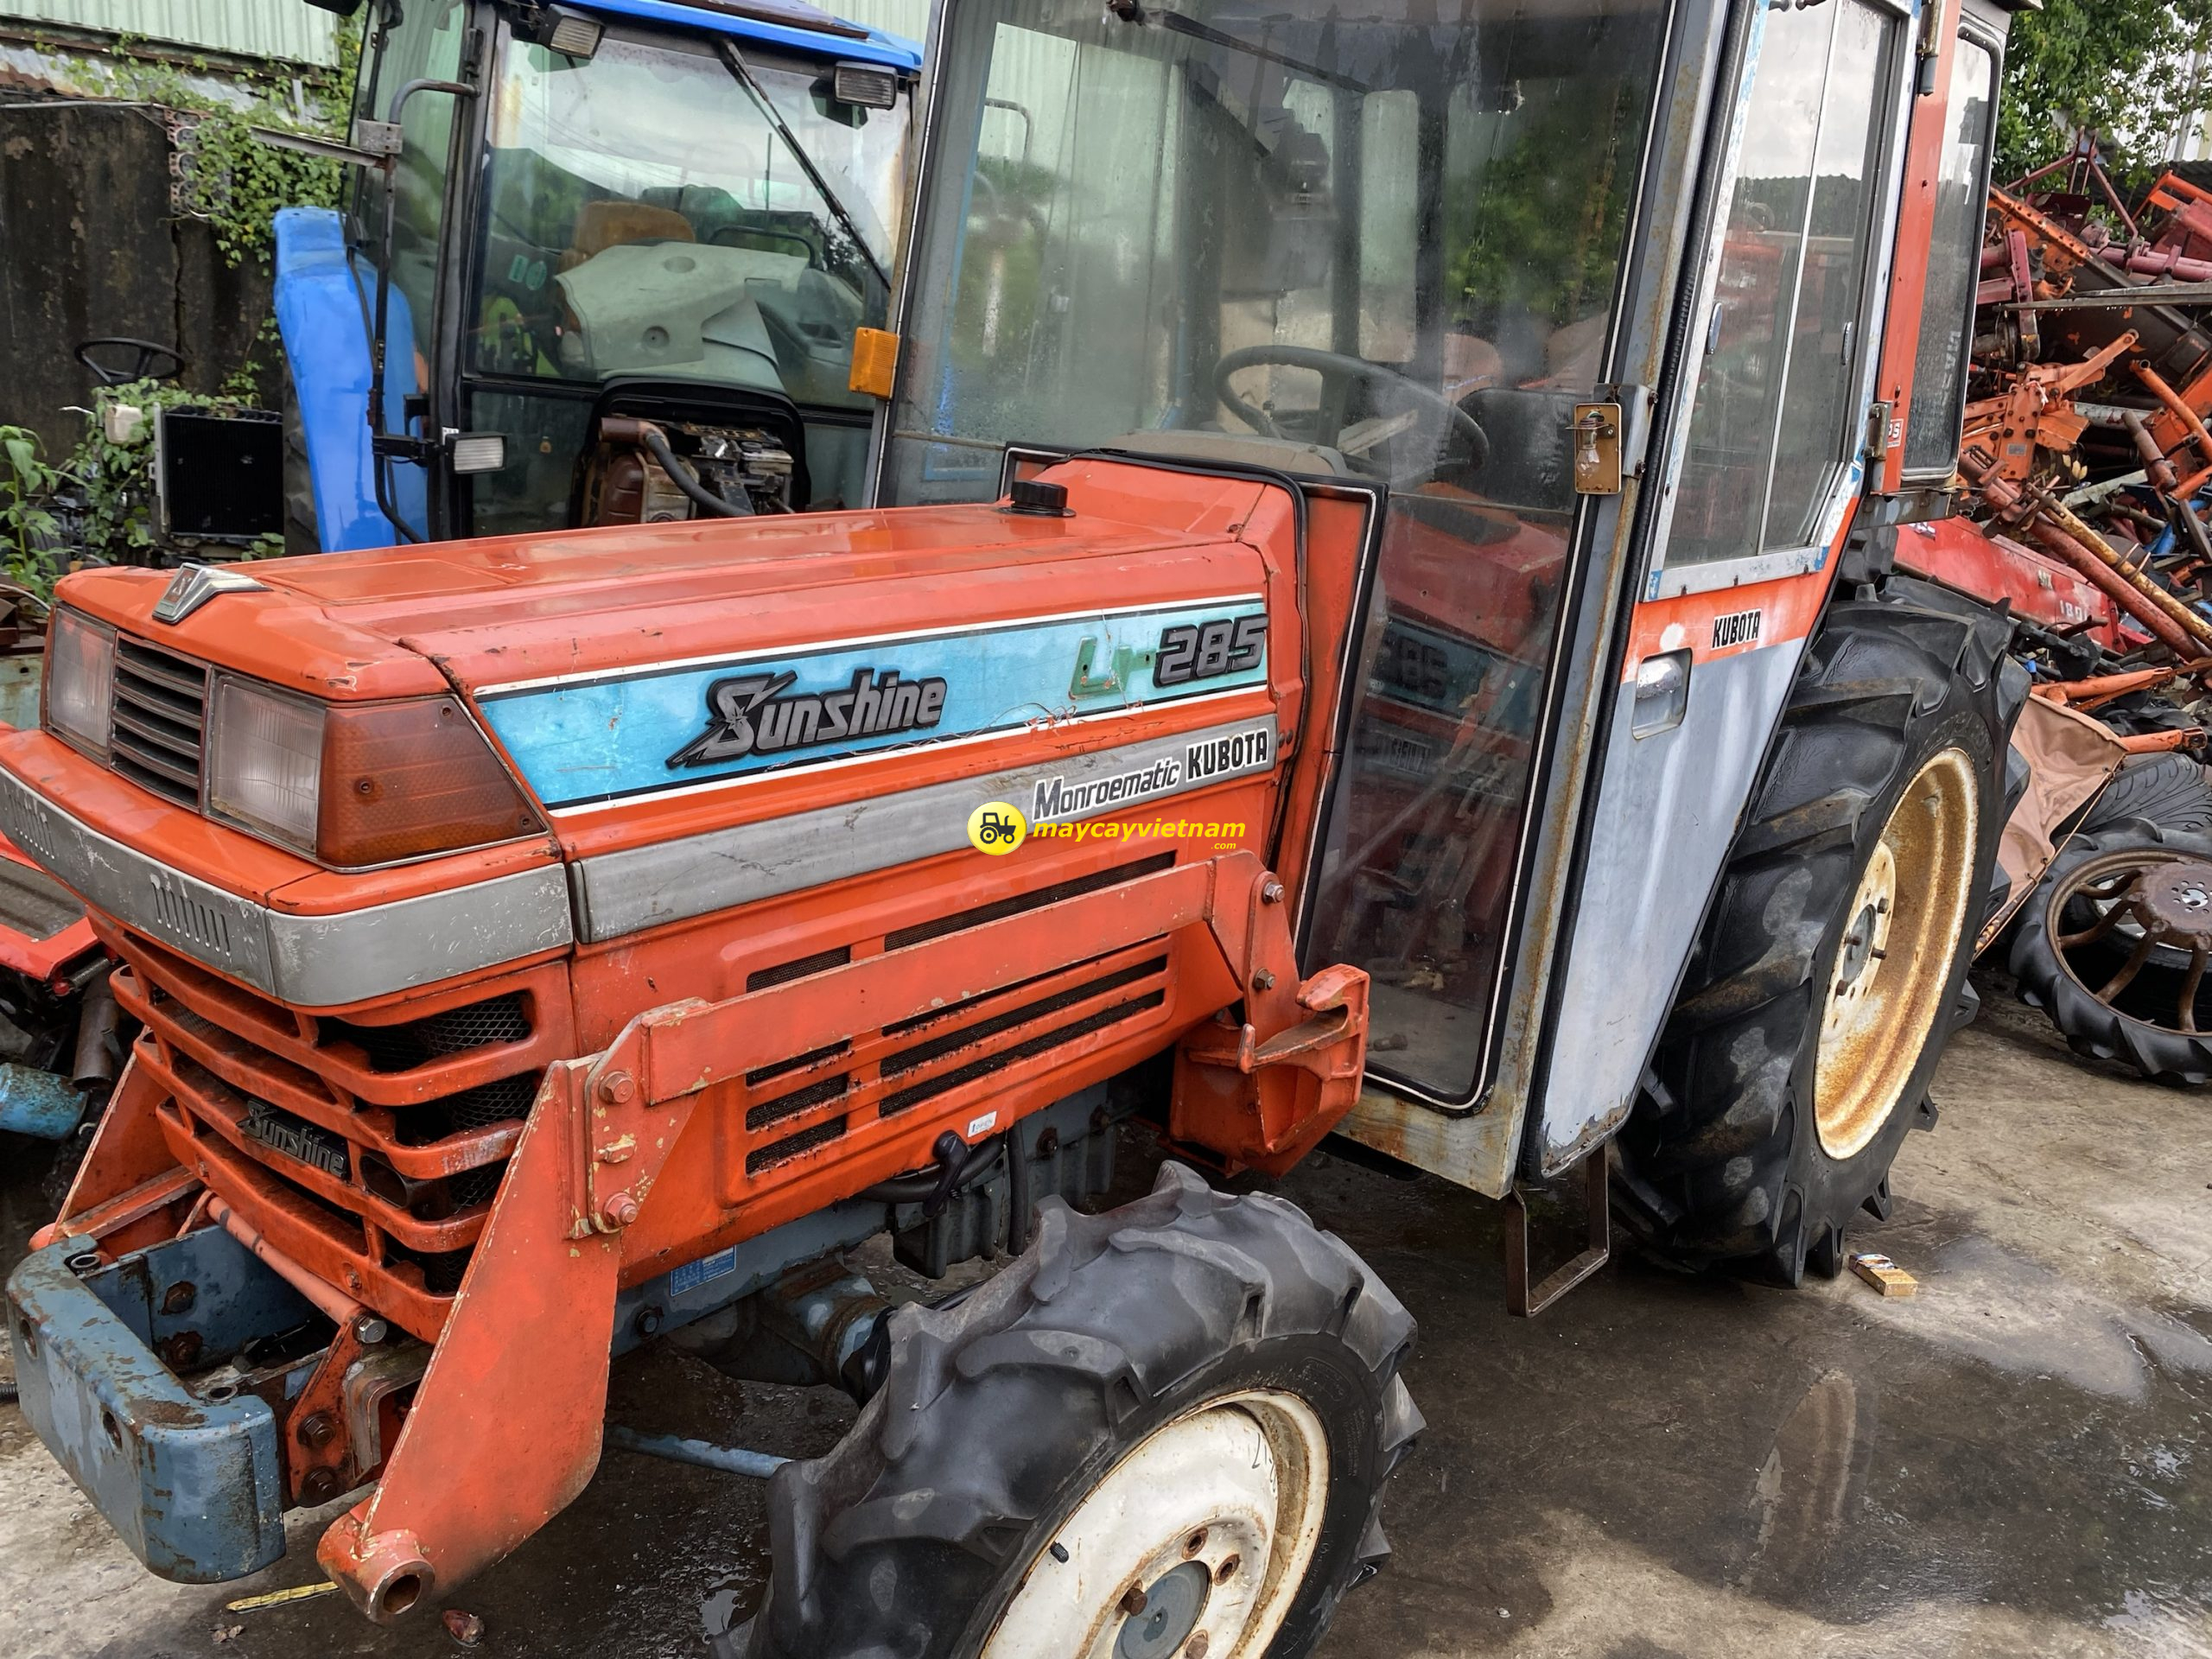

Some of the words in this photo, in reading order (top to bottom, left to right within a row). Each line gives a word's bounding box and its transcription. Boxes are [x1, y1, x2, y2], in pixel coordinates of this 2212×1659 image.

[1153, 613, 1268, 688] 285
[1712, 611, 1761, 648] KUBOTA
[665, 667, 947, 770] Sunshine
[1033, 760, 1180, 820] Monroematic
[1188, 730, 1268, 779] KUBOTA
[236, 1099, 346, 1178] Sunshine
